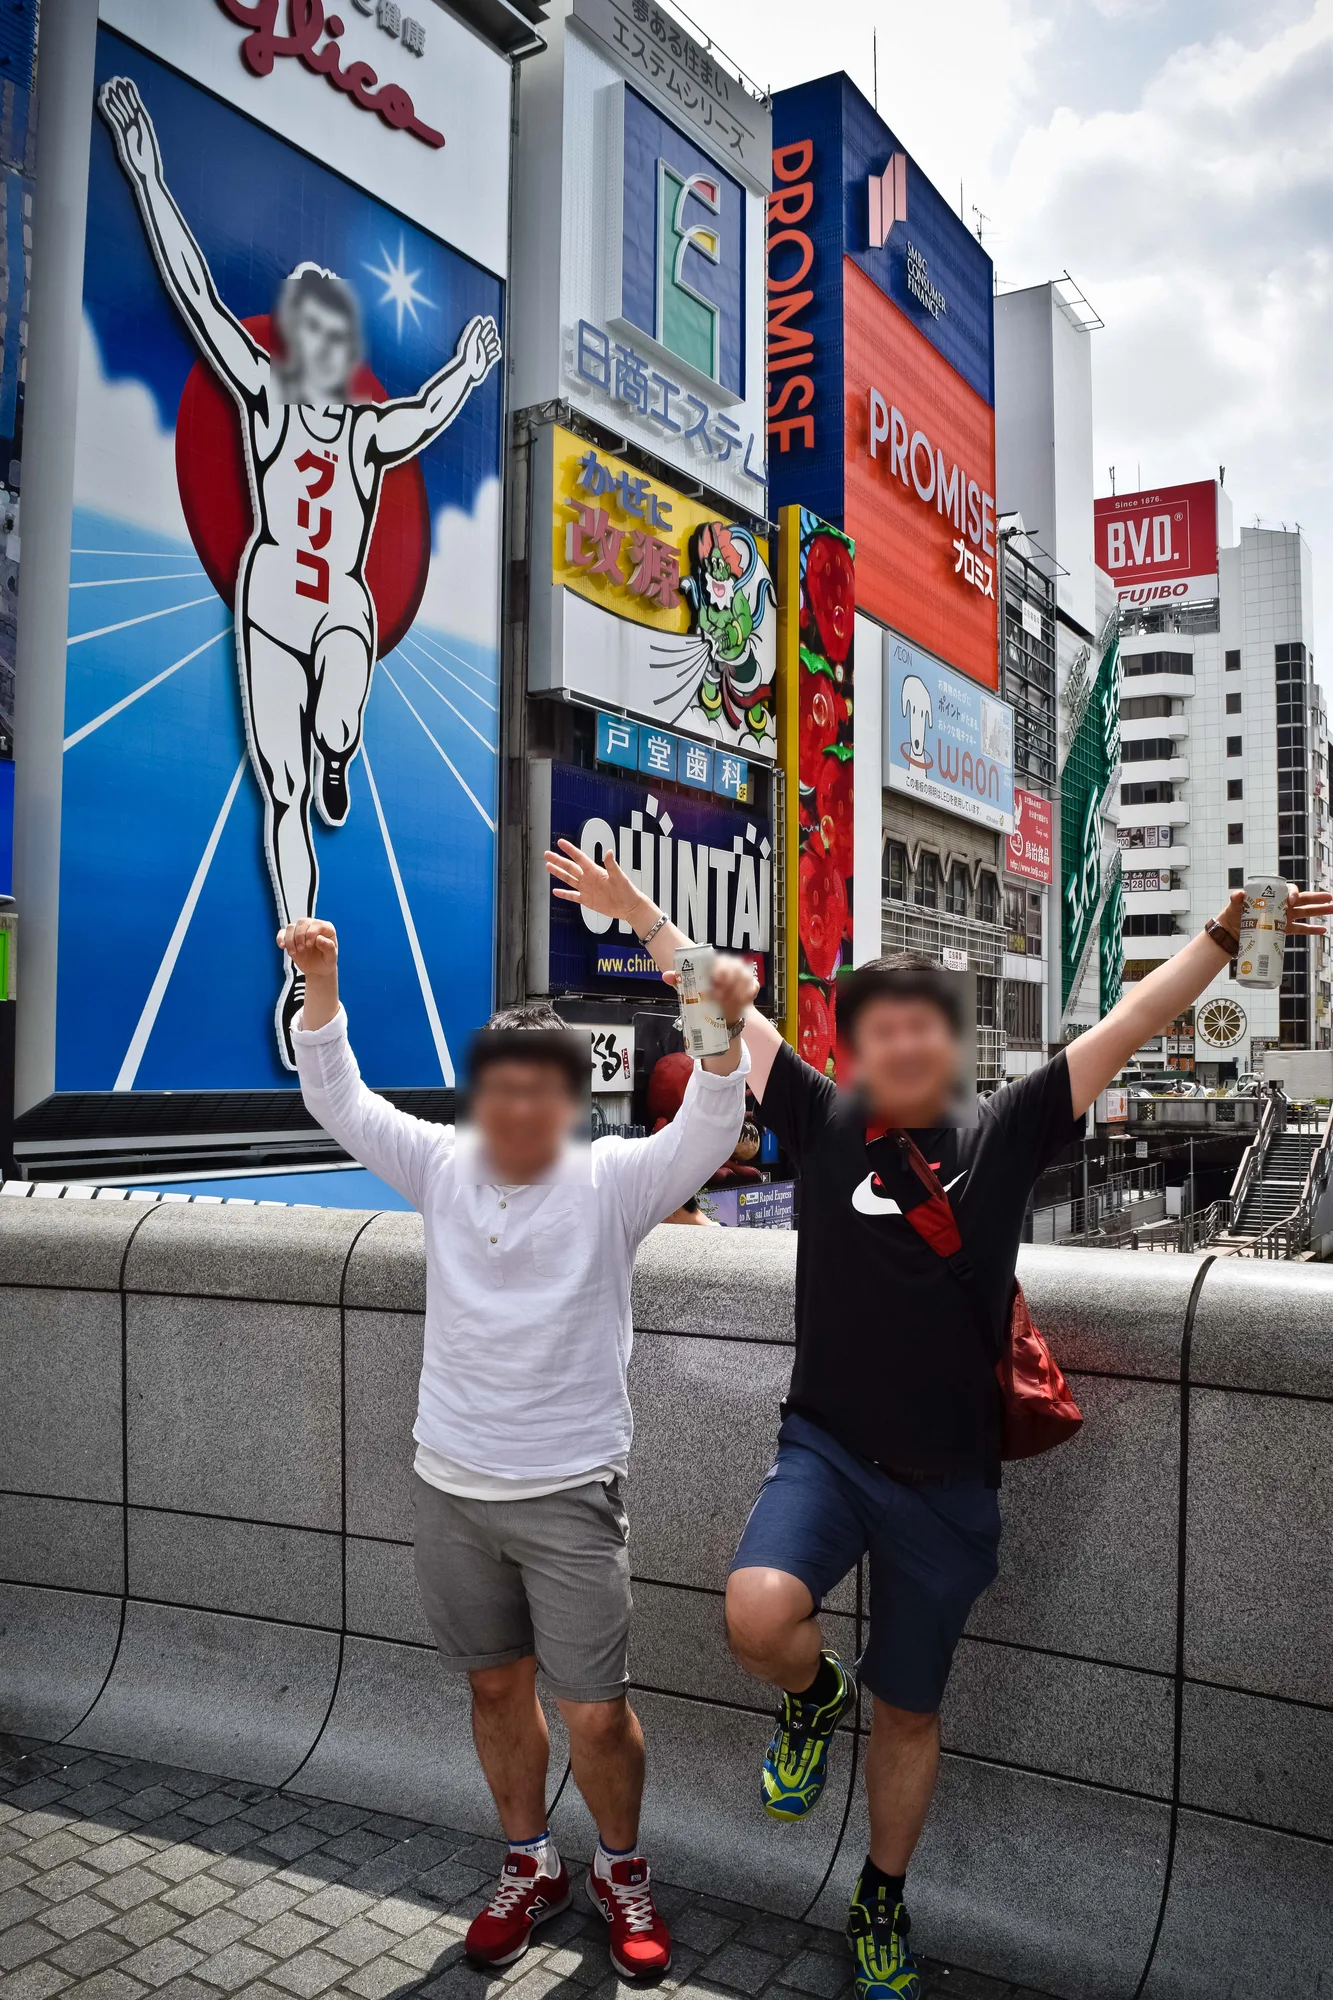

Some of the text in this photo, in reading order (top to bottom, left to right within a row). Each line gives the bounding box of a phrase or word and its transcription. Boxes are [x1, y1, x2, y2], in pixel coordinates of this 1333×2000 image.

[631, 0, 729, 100] 夢ある住まい
[612, 16, 744, 158] エステムシリーズ
[907, 241, 928, 276] SMBC
[907, 258, 947, 316] CONSUMER
[767, 139, 816, 453] PROMISE
[907, 273, 940, 321] FINANCE
[577, 318, 770, 487] 日商エステム
[576, 450, 673, 532] かぜに
[868, 385, 995, 558] PROMISE
[1114, 500, 1138, 509] Since
[294, 448, 339, 604] グリコ
[565, 497, 682, 610] 改源
[1107, 514, 1180, 569] B.V.D.
[953, 537, 995, 600] プロミス
[1118, 583, 1189, 606] FUJIBO
[606, 721, 741, 792] 戸堂歯科
[937, 737, 1000, 802] WAON
[580, 793, 772, 953] CHINTAI
[745, 1207, 763, 1221] Ksai
[775, 1205, 792, 1218] Airport
[760, 1190, 774, 1205] Rapid
[774, 1189, 792, 1203] Express
